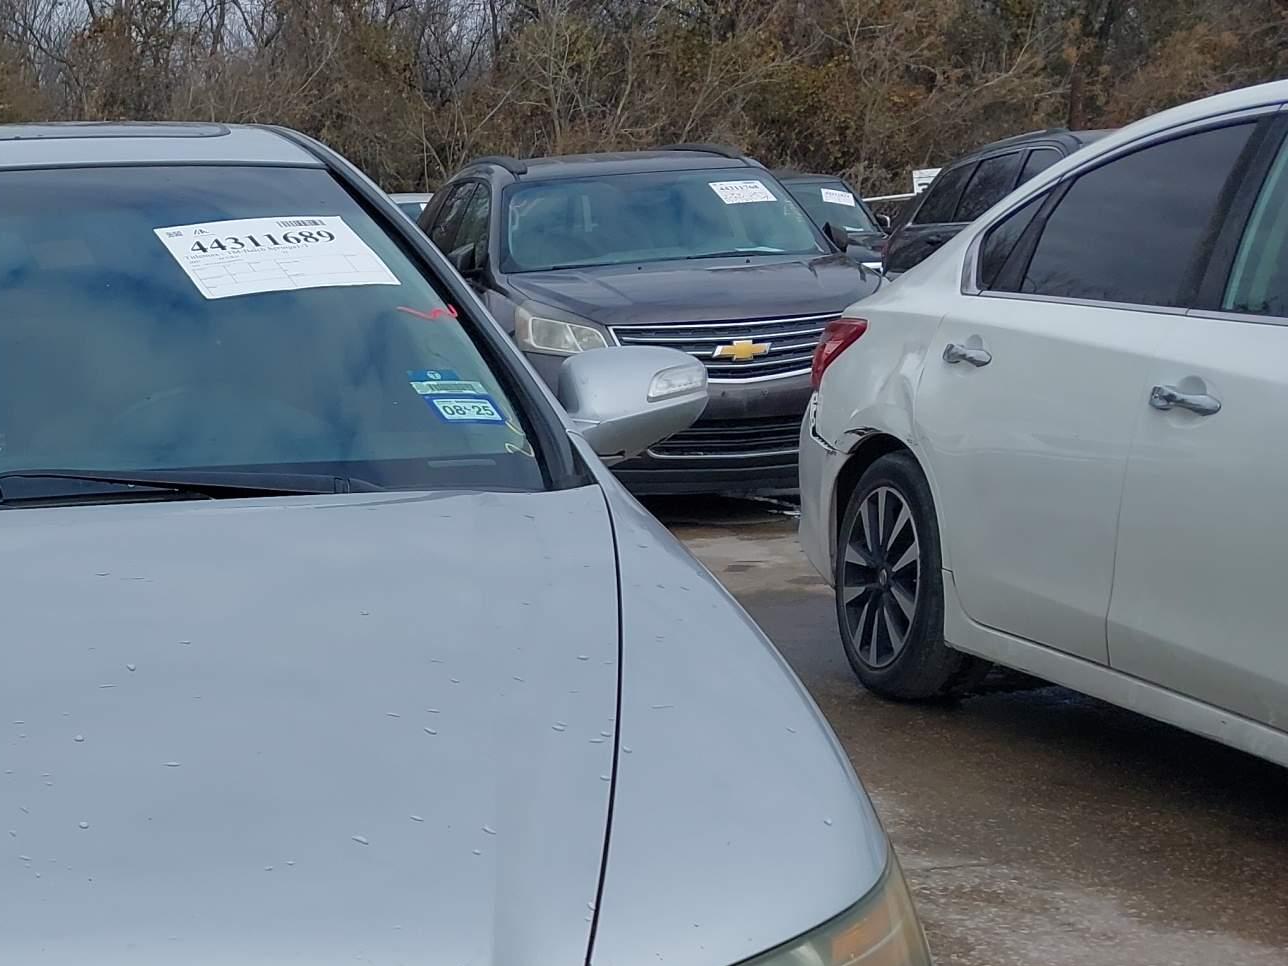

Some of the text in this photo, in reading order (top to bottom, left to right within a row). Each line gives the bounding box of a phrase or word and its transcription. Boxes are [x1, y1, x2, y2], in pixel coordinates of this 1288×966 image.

[190, 230, 336, 253] 44311689
[442, 404, 495, 416] 08 25
